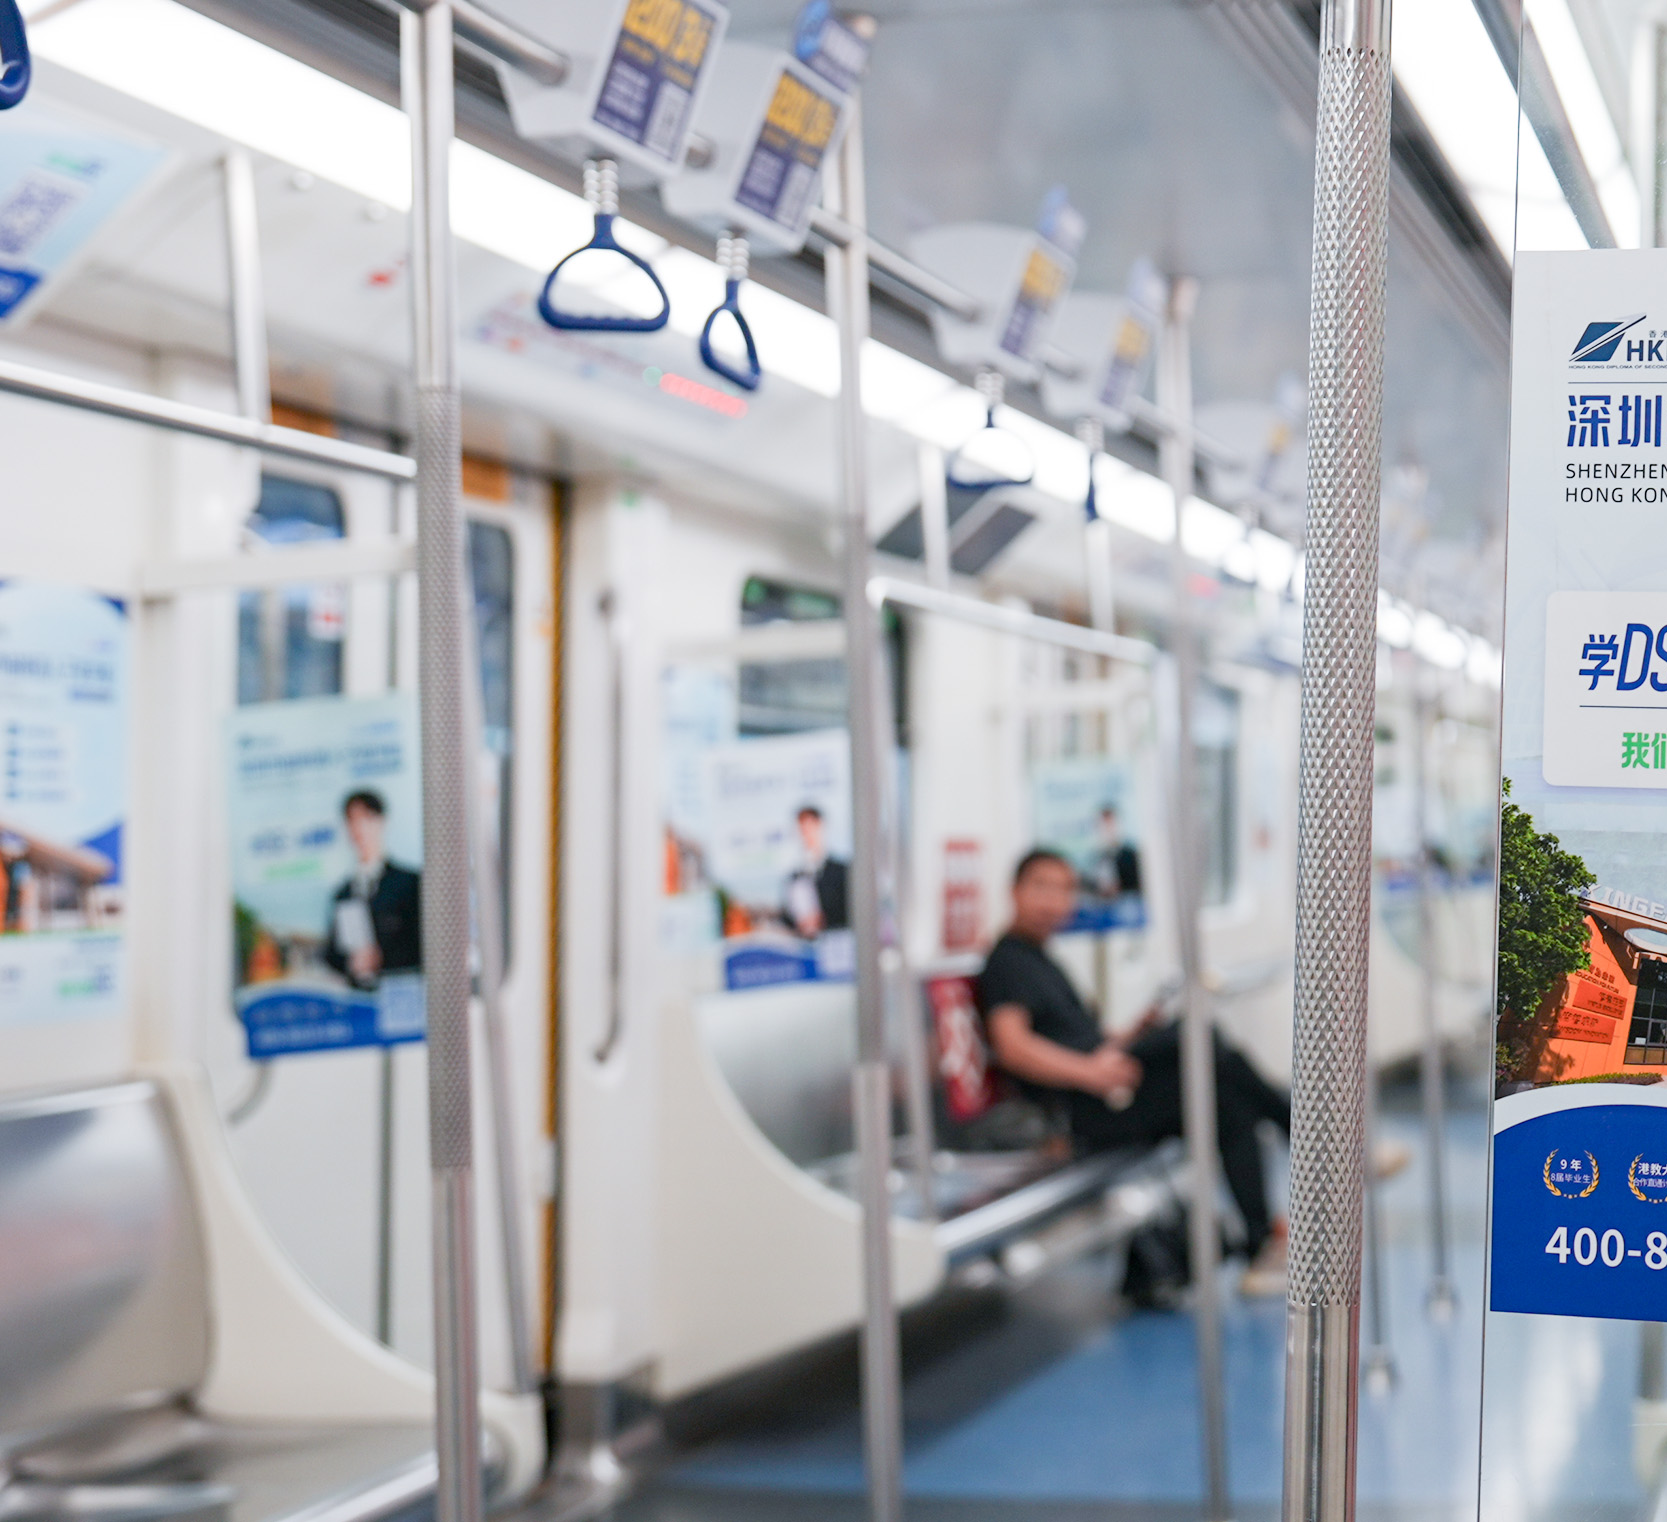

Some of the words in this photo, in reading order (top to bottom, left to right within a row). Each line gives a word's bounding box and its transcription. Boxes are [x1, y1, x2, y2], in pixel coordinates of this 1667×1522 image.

[1565, 487, 1624, 503] HONG
[1550, 1173, 1591, 1185] 8届毕业生
